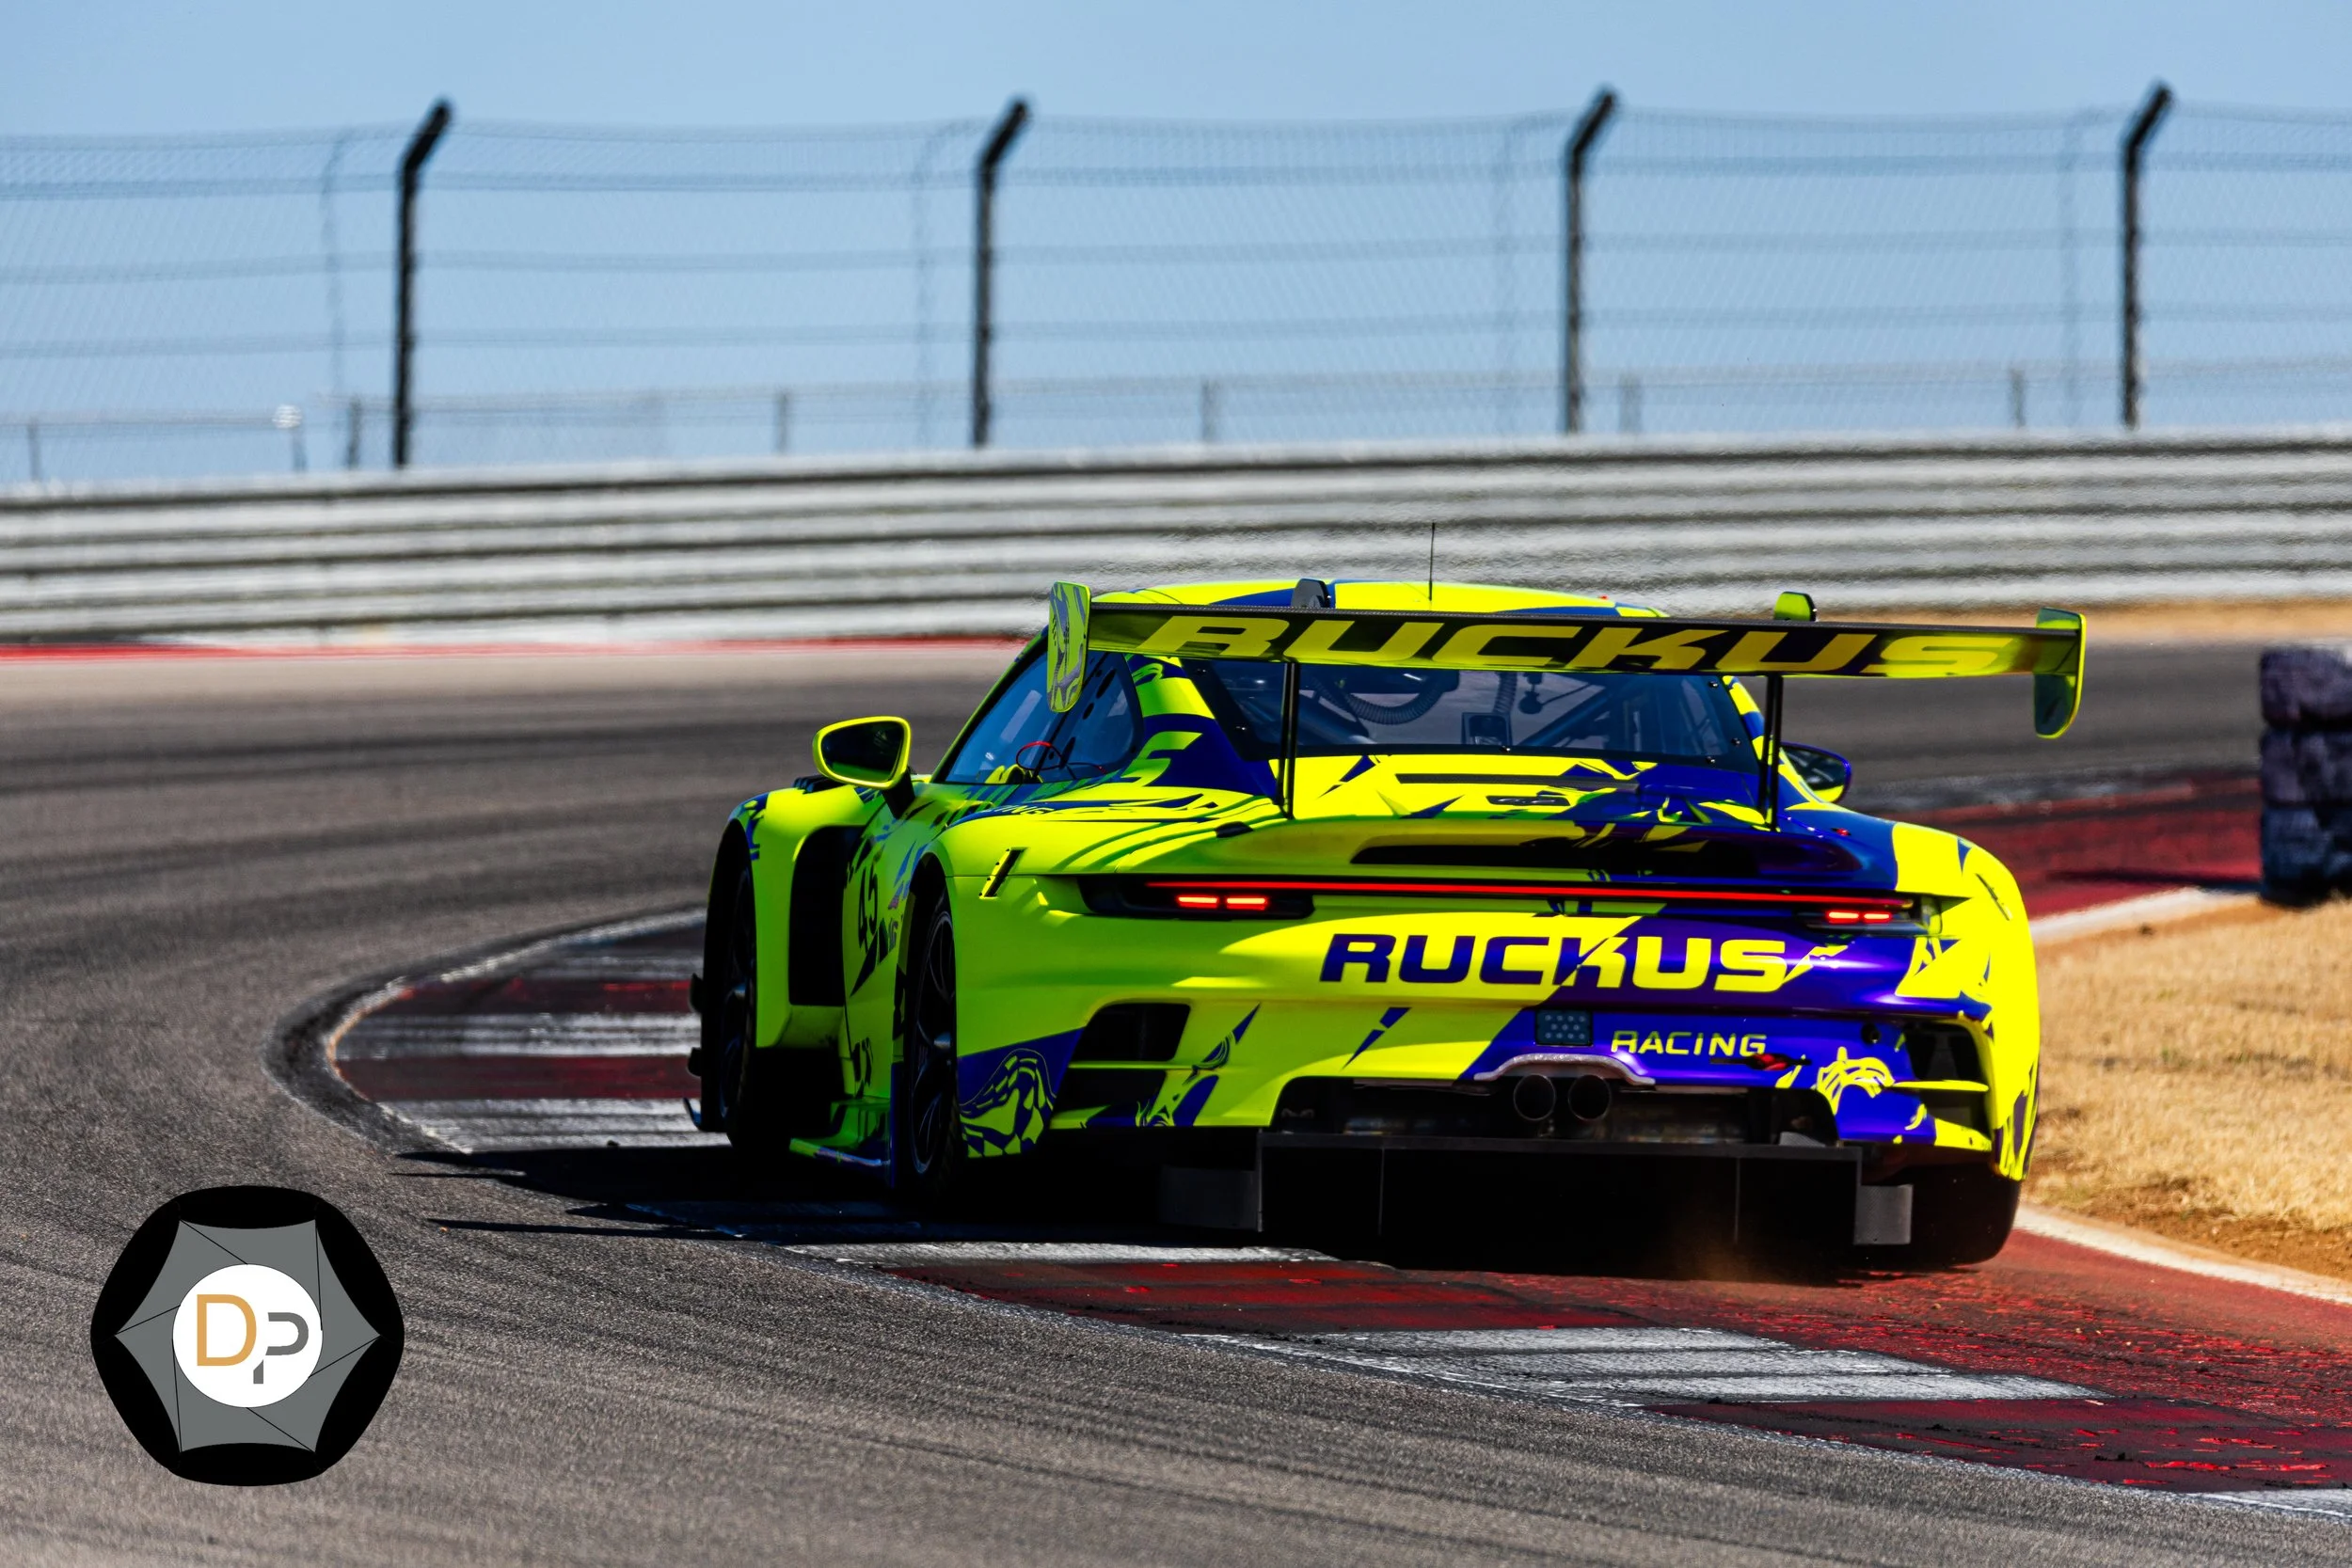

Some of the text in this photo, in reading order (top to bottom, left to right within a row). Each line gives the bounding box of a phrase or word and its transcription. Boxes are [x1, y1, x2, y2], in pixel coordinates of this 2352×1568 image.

[1136, 616, 2013, 675] RUCKUS
[1319, 933, 1789, 993] RUCKUS
[1610, 1031, 1766, 1056] RACING
